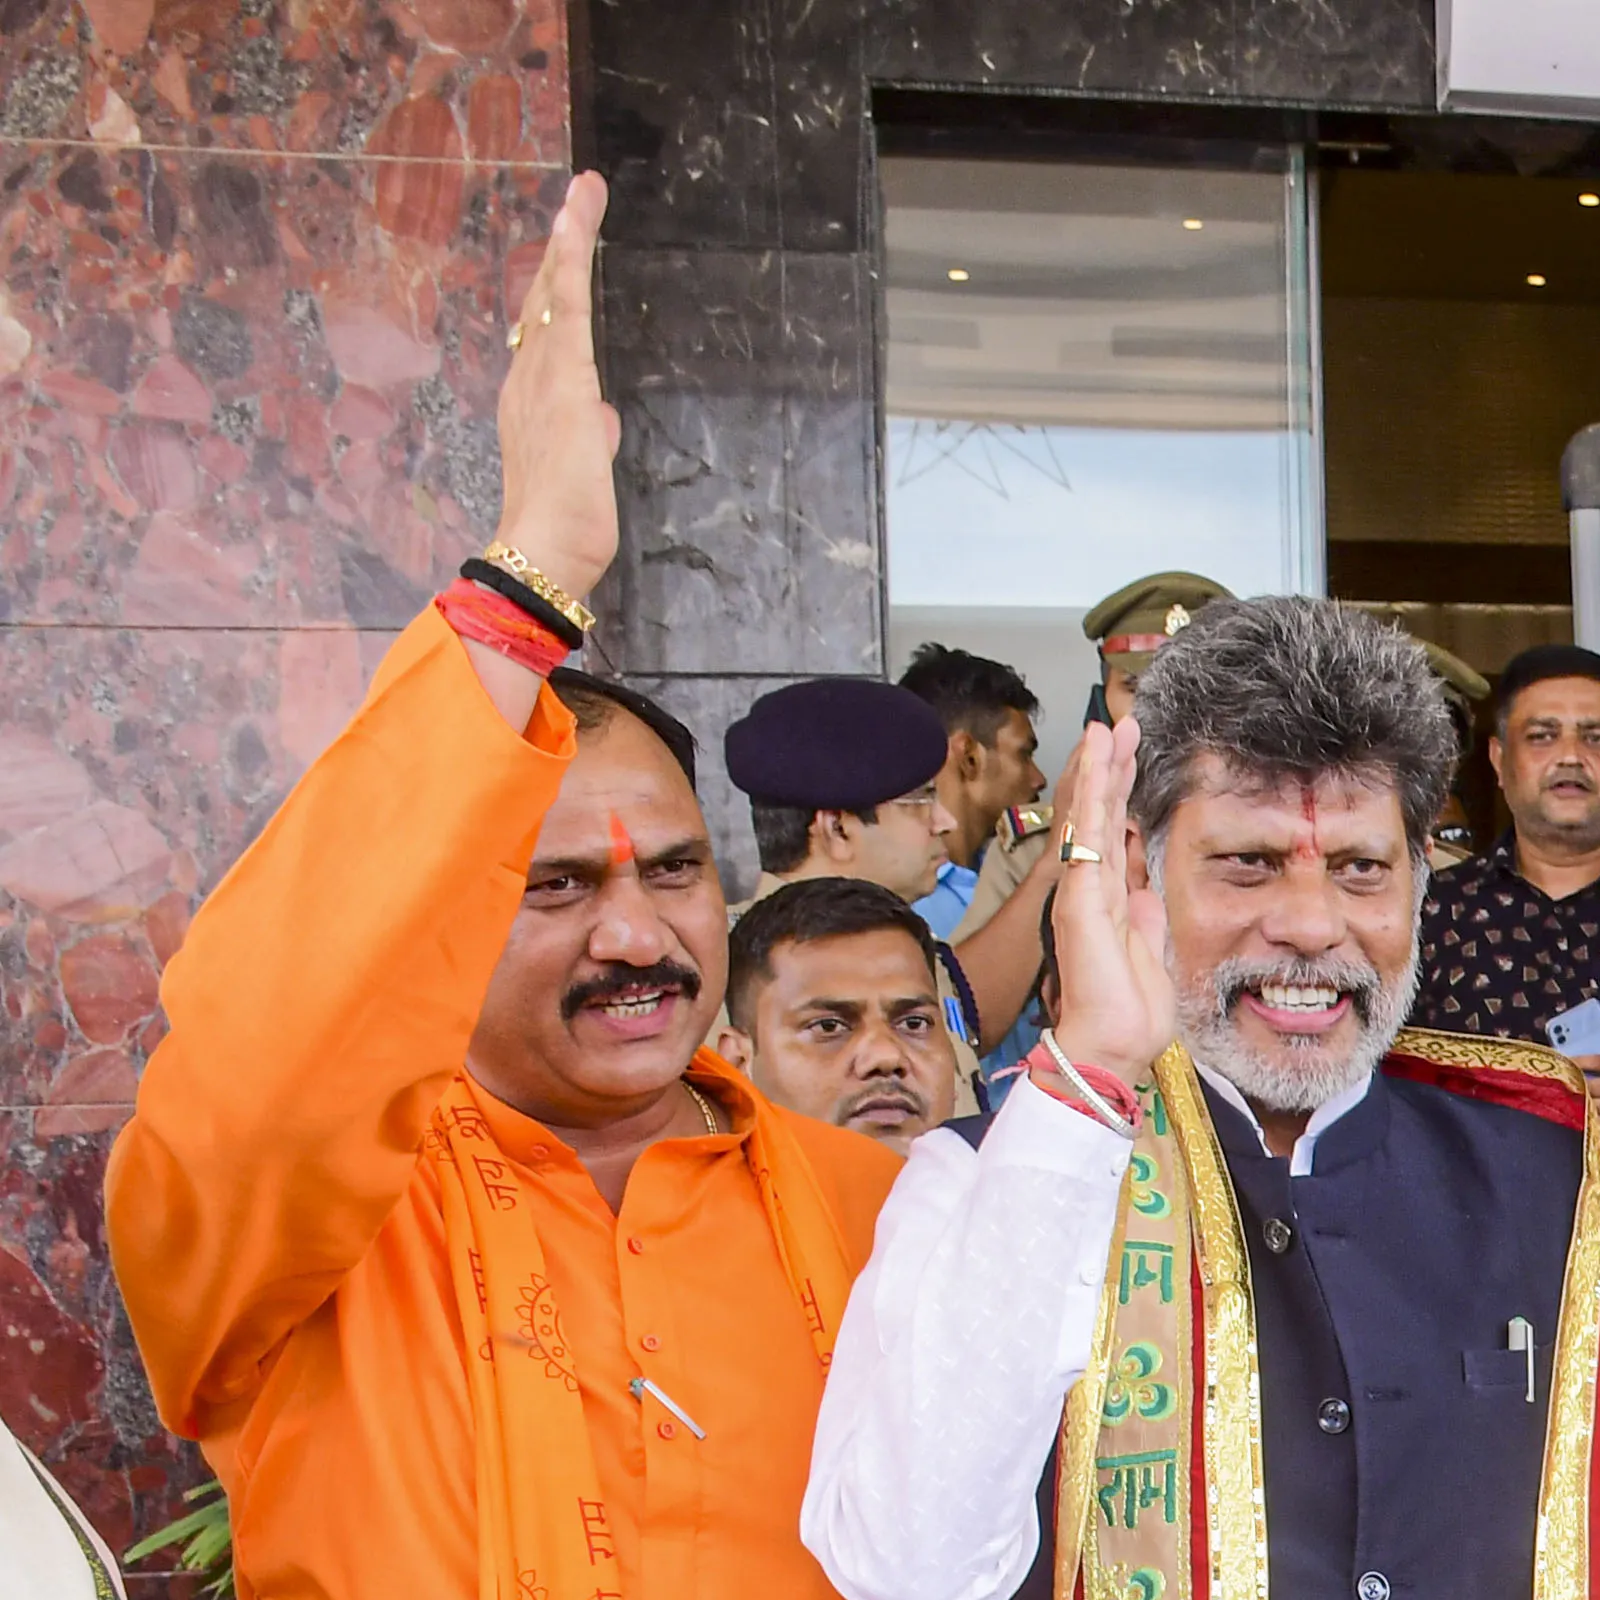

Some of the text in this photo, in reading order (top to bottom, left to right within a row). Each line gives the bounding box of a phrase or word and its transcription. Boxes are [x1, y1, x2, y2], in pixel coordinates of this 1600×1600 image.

[473, 1154, 518, 1211] जय
[1095, 1449, 1177, 1528] राम
[577, 1496, 616, 1566] राम
